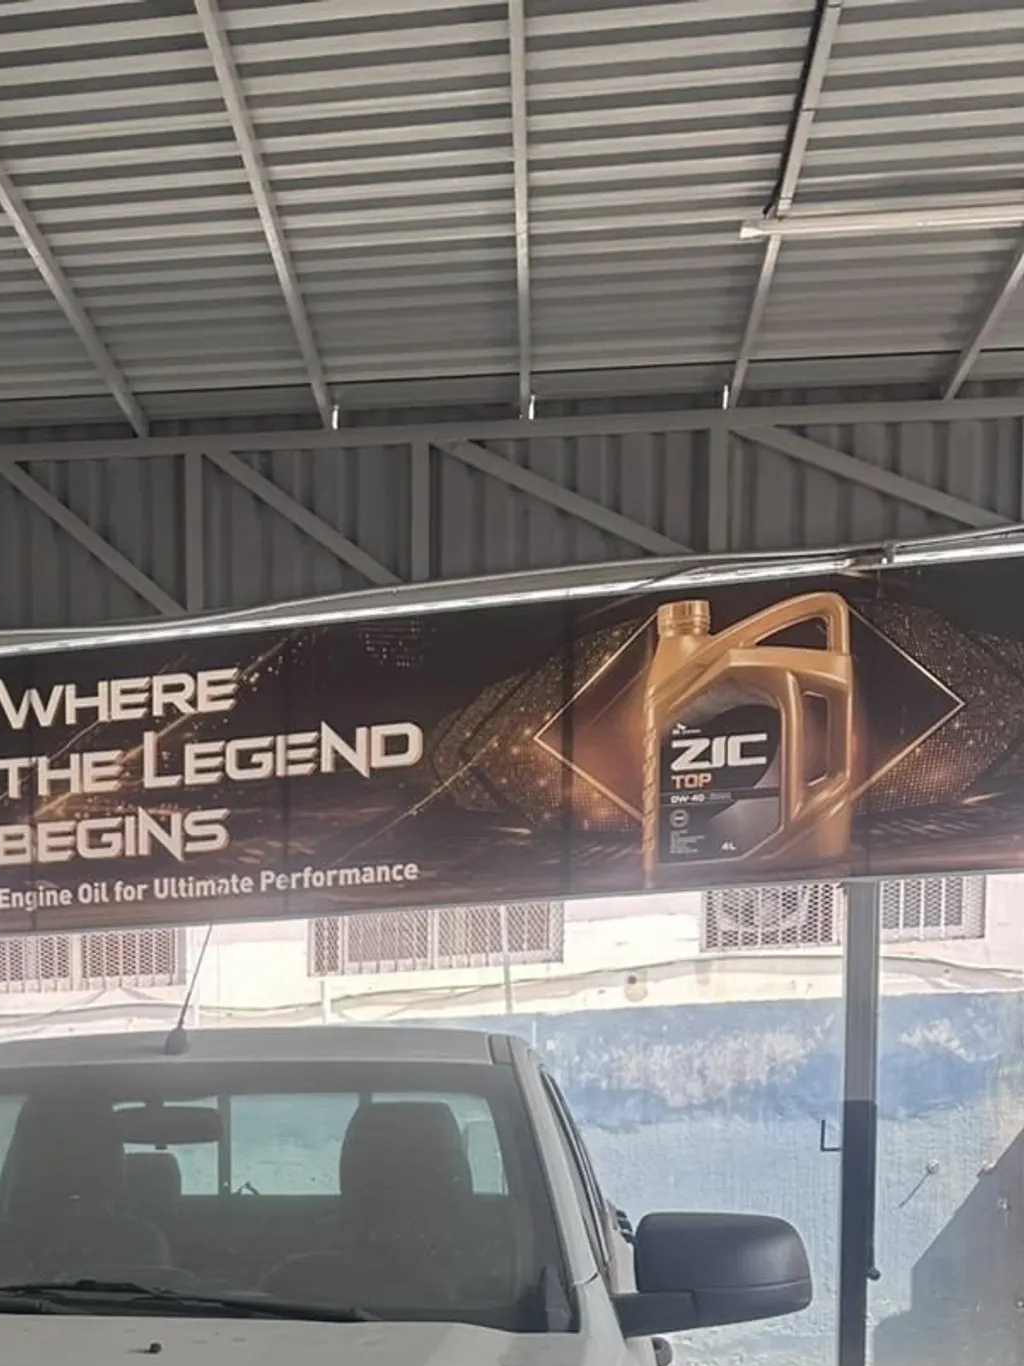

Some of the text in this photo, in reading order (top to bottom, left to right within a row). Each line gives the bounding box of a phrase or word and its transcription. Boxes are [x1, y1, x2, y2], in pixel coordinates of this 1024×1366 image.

[143, 720, 424, 790] LEGEND
[670, 732, 768, 772] ZIC
[670, 773, 712, 789] TOP
[80, 881, 109, 904] Oil
[114, 880, 149, 902] for
[153, 873, 254, 900] Ultimate
[260, 862, 420, 893] Performance
